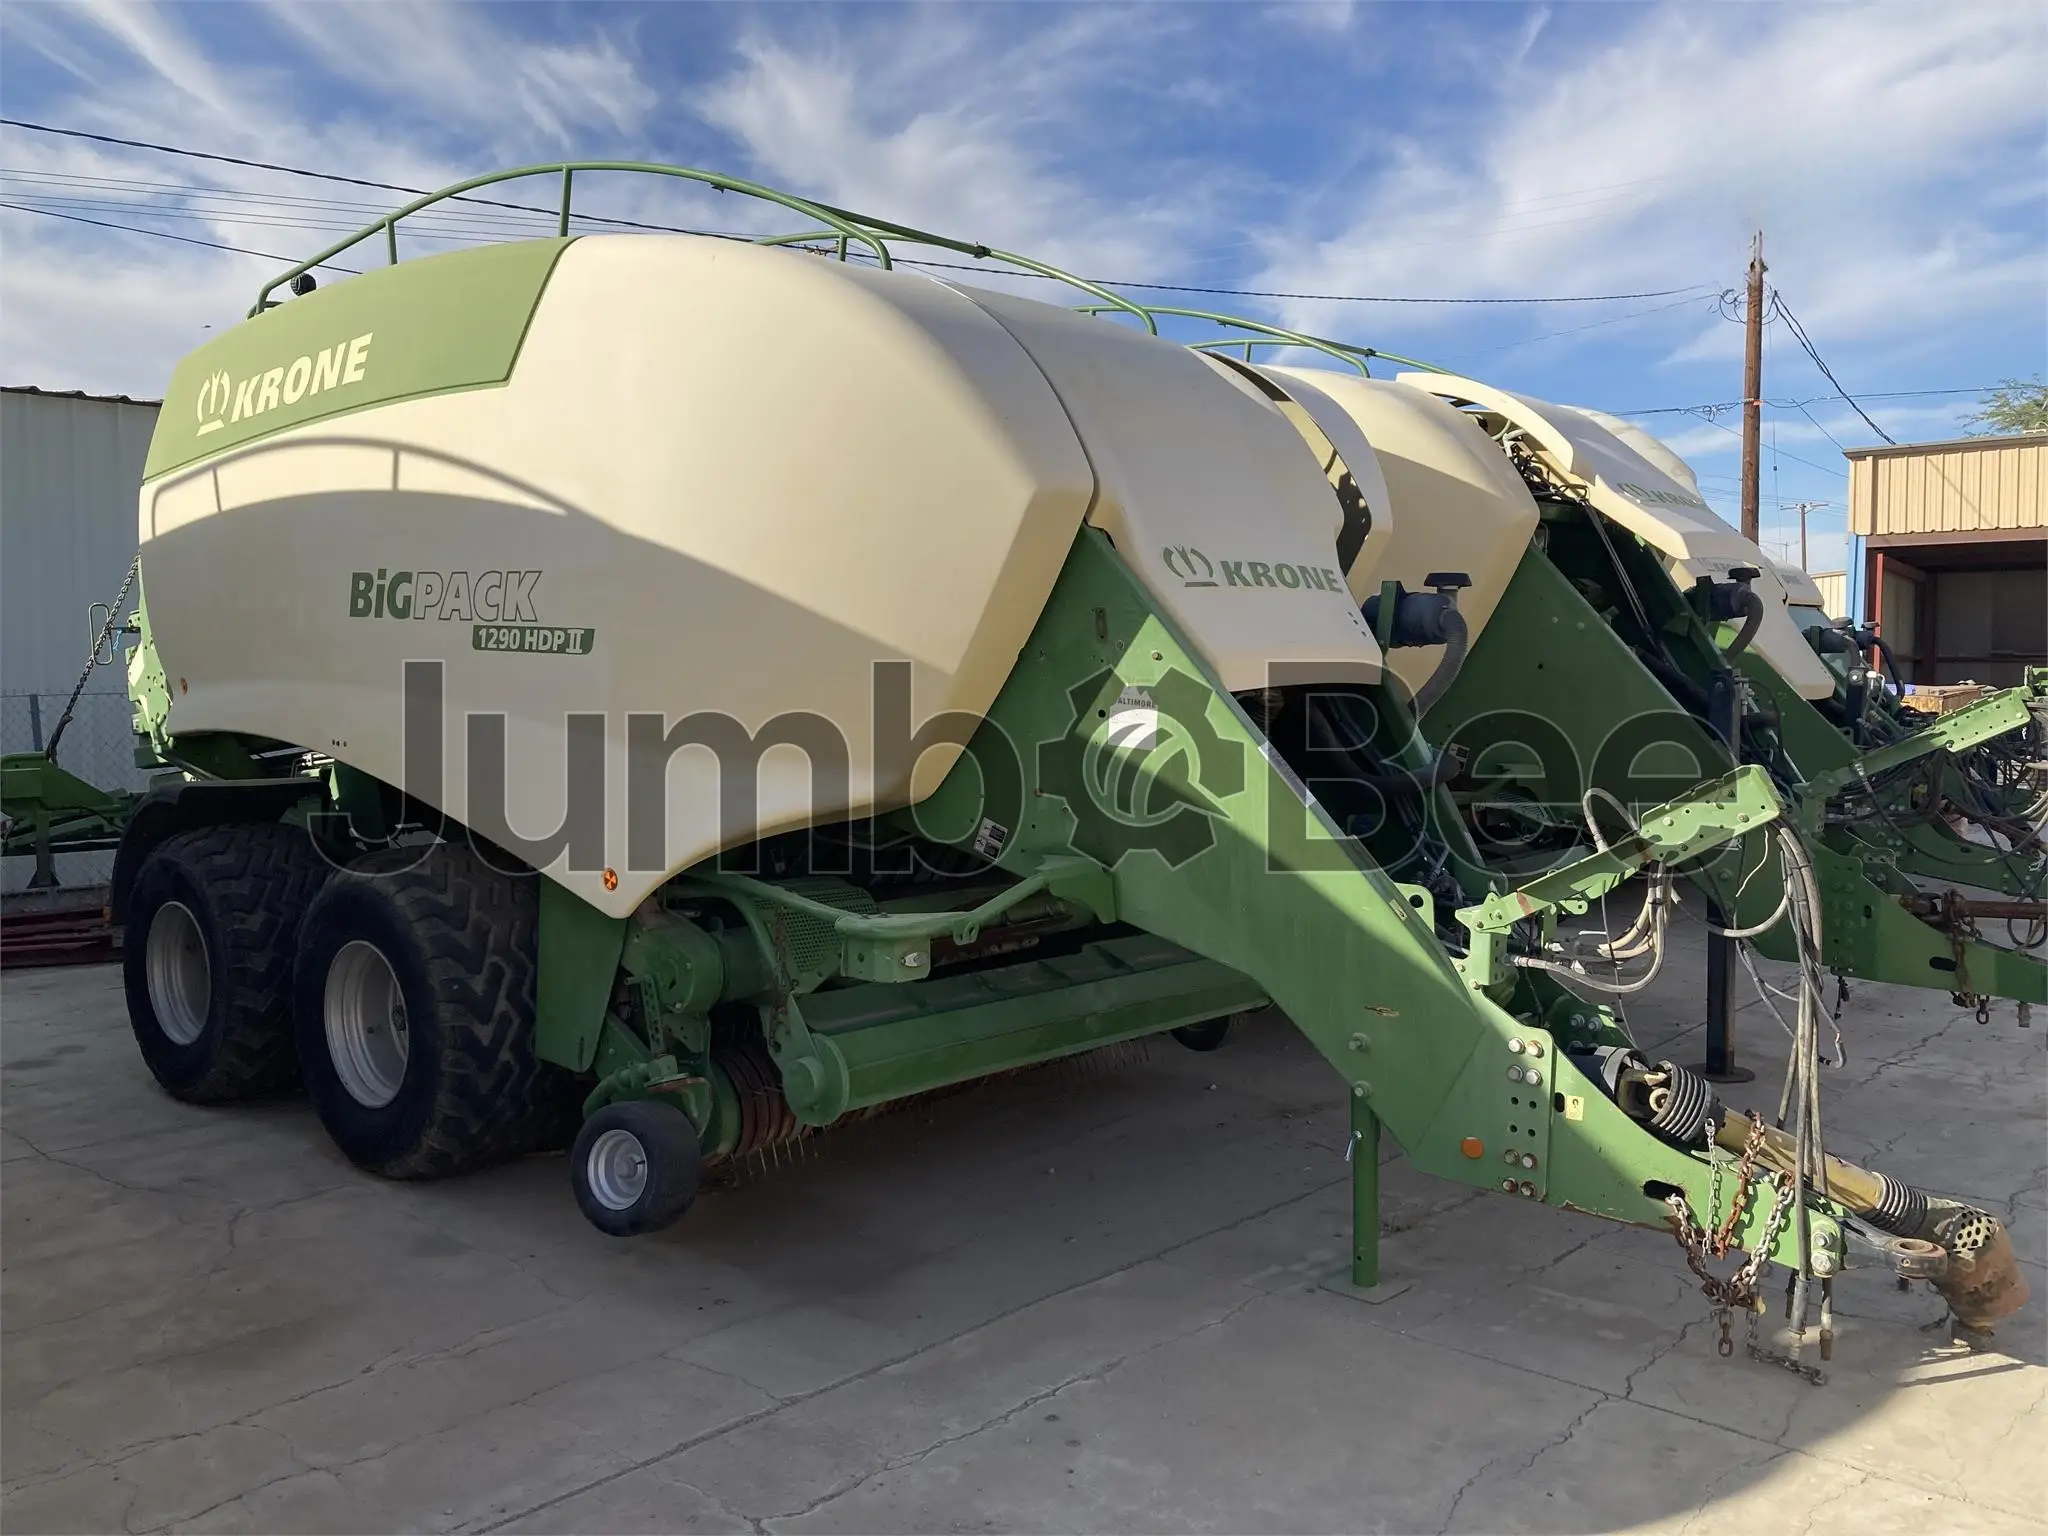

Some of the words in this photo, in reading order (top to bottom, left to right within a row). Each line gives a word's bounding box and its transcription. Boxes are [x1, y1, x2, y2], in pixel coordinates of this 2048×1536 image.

[230, 332, 374, 424] KRONE
[1220, 560, 1344, 594] KRONE
[478, 627, 521, 649] 1290
